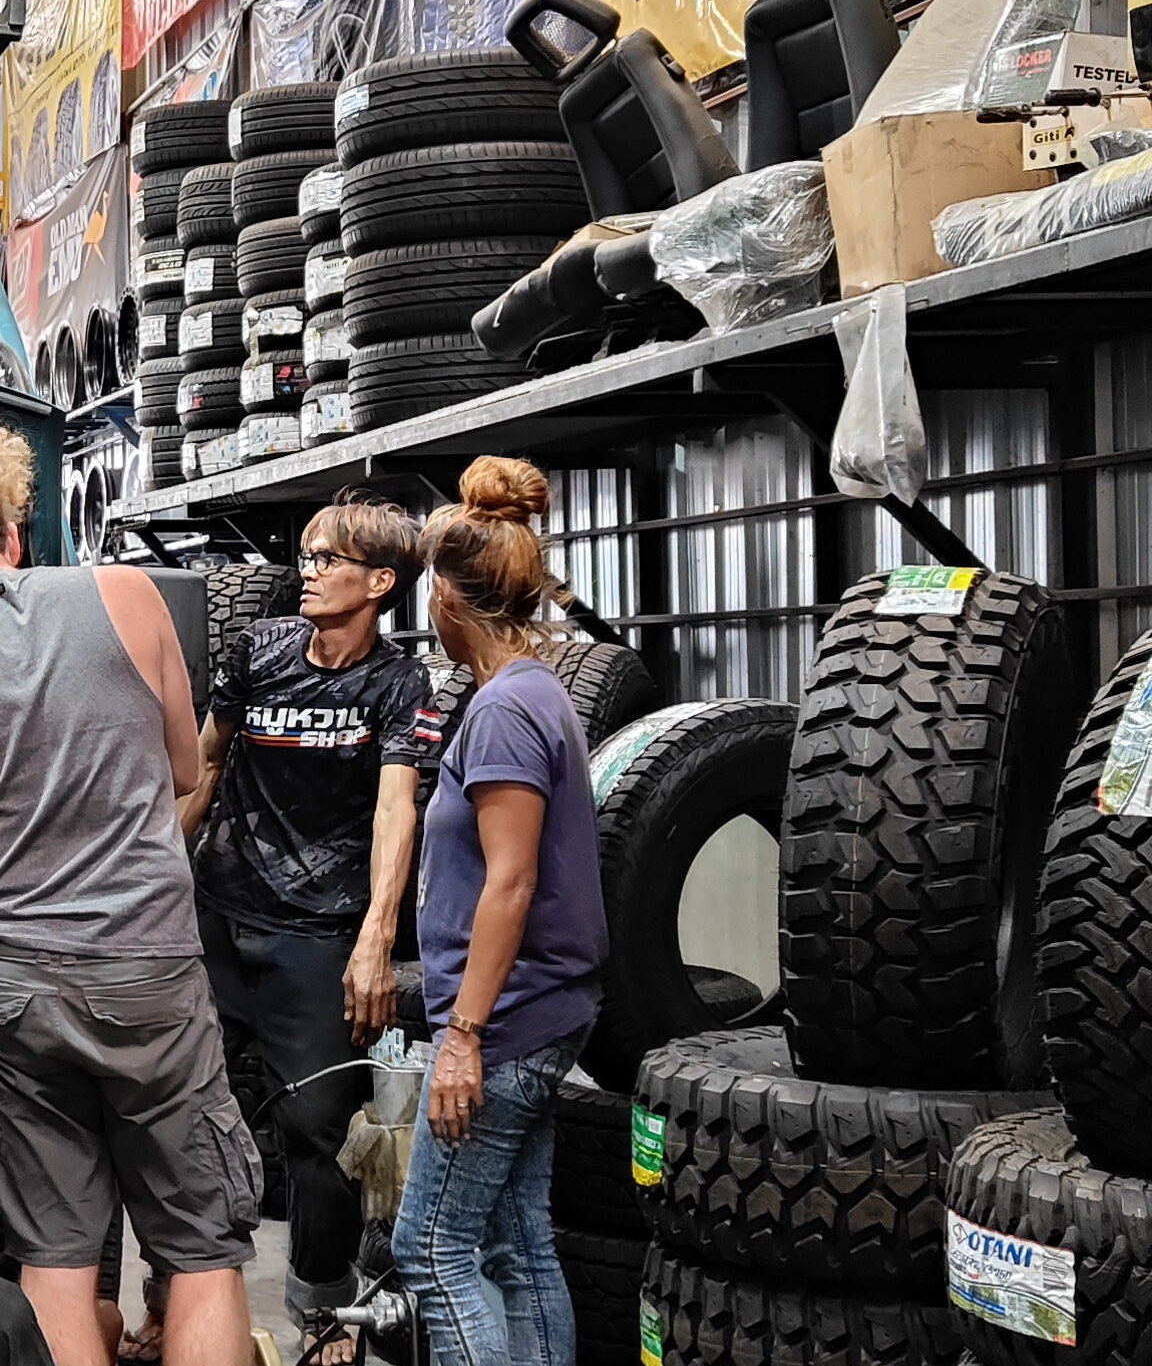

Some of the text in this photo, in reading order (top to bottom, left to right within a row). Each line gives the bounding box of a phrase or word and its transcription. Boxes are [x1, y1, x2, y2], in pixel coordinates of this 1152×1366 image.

[1033, 129, 1060, 144] Giti
[50, 218, 67, 249] OLD
[300, 726, 367, 747] SHOP
[968, 1231, 1033, 1268] OTANI
